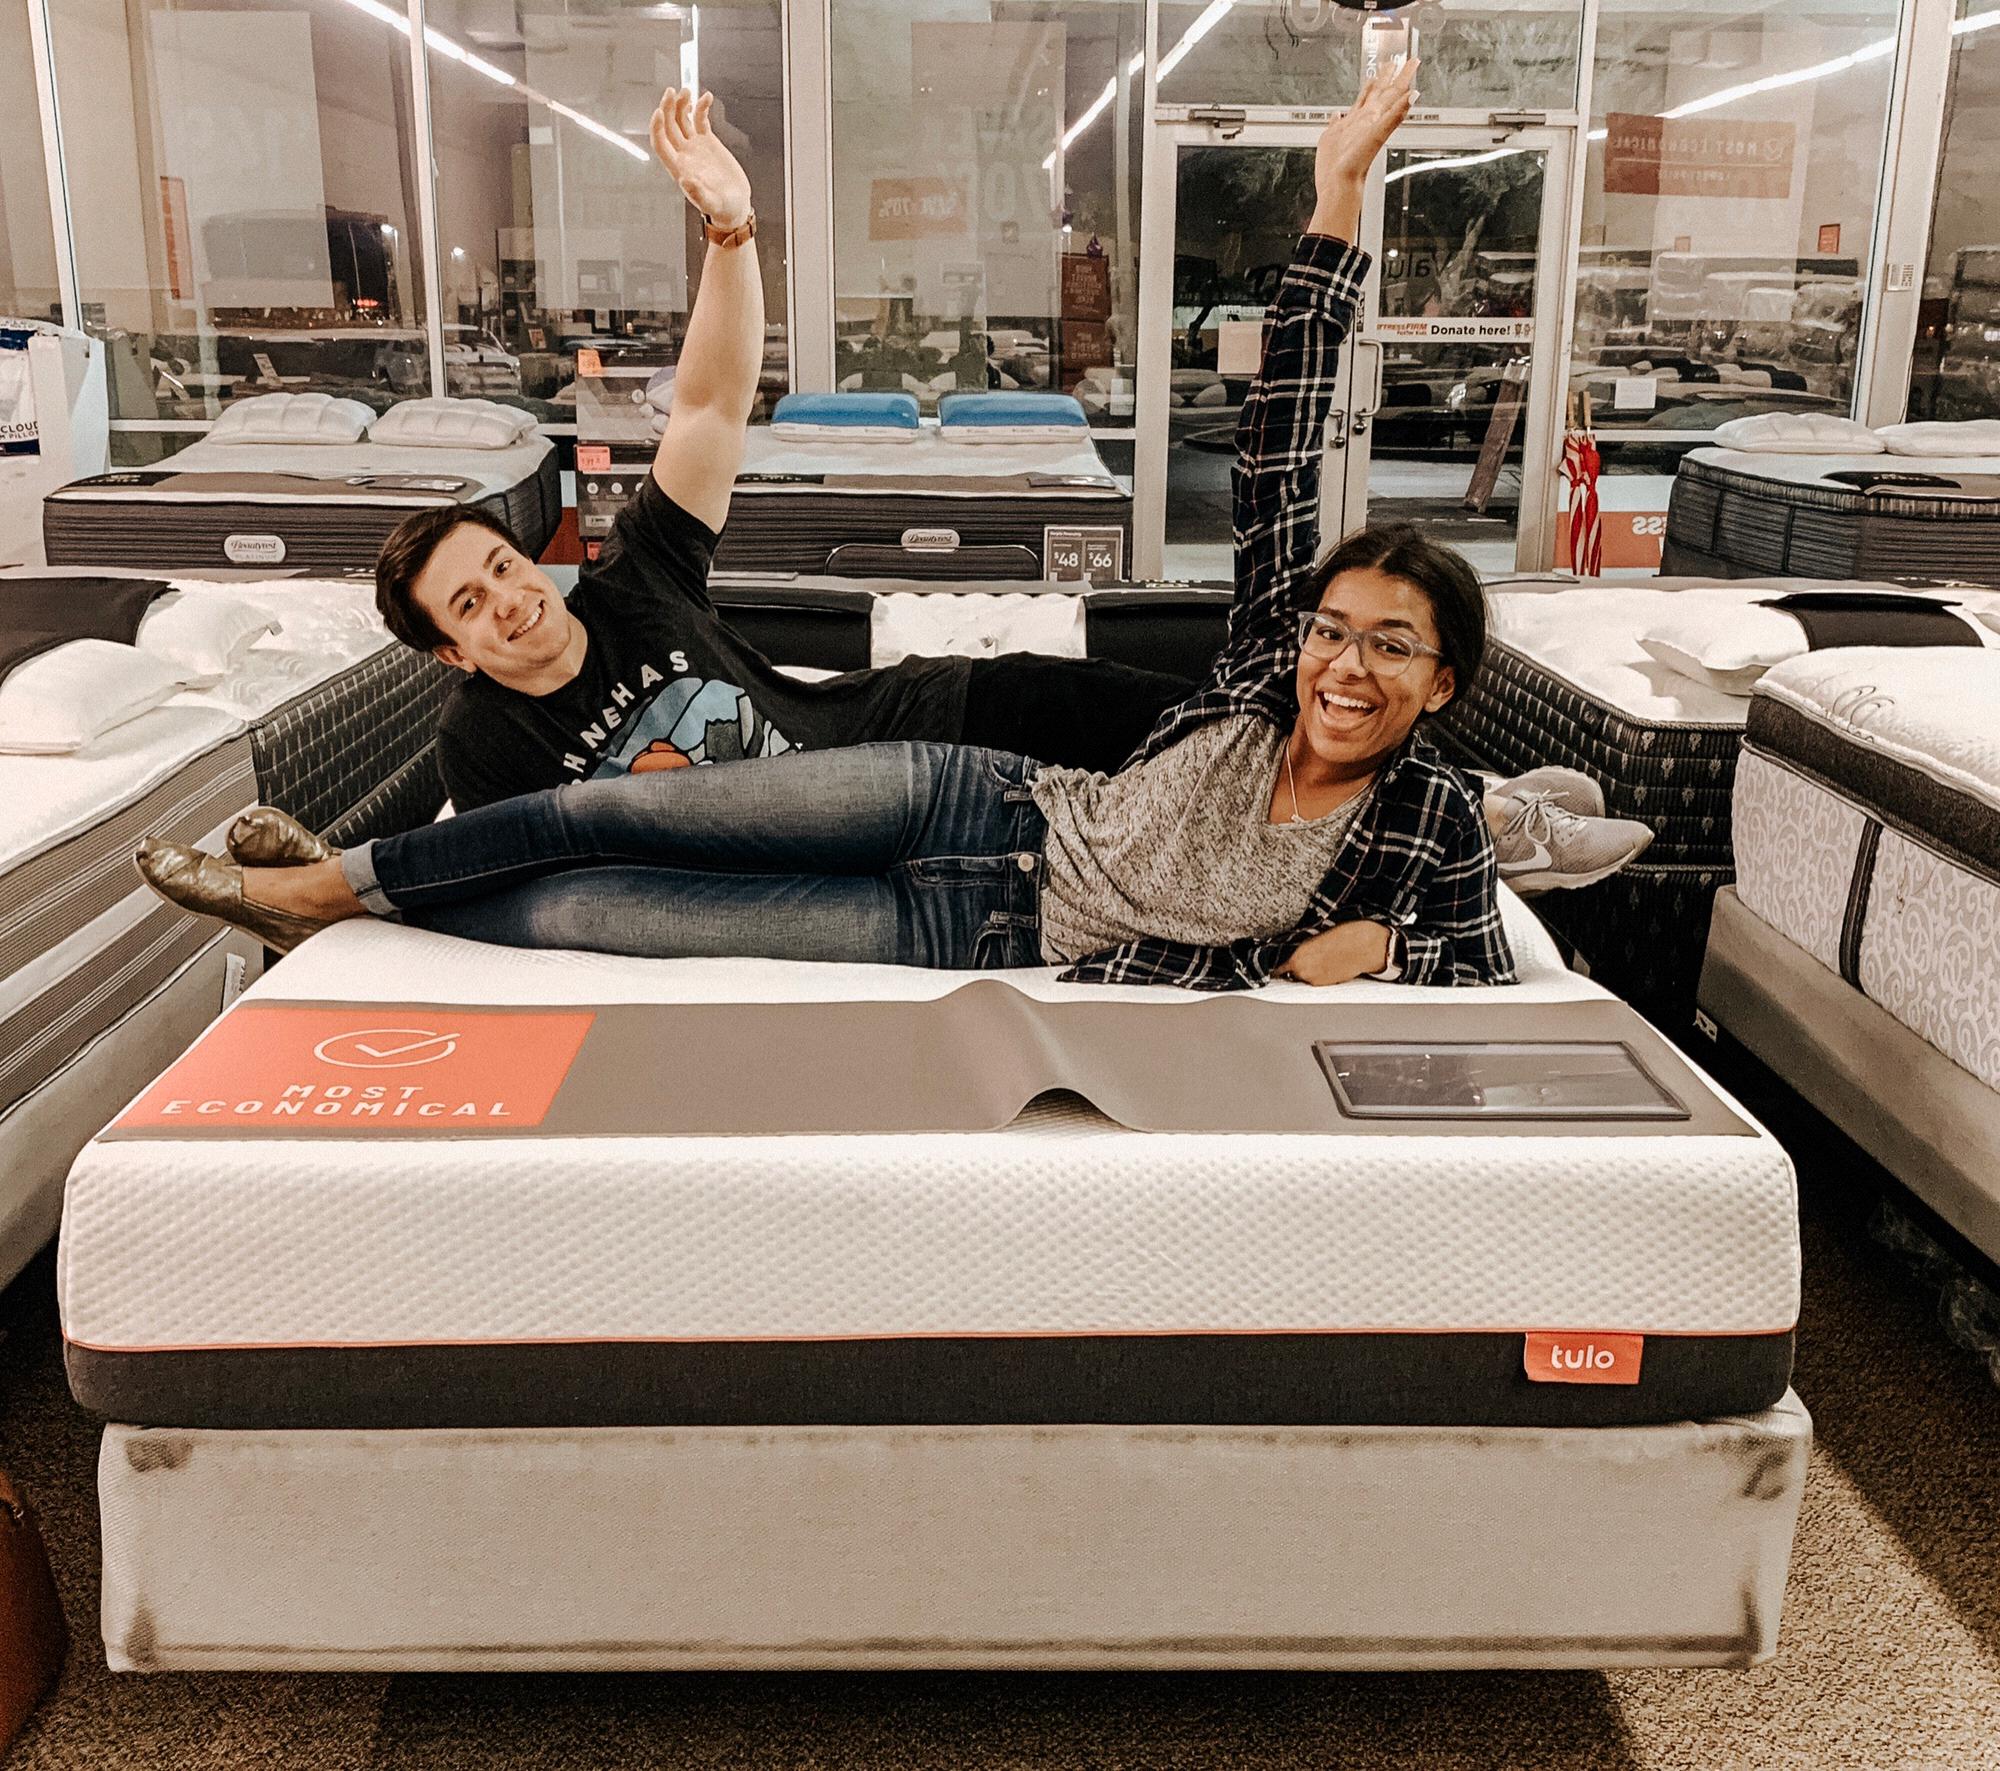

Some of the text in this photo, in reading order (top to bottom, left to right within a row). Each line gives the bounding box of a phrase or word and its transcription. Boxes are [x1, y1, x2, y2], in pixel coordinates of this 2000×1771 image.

[1430, 324, 1511, 336] Donate here!
[1053, 551, 1079, 568] $48
[1088, 551, 1113, 568] $66
[280, 1084, 424, 1100] MOST
[159, 1099, 512, 1117] ECONOMICAL
[1551, 1344, 1615, 1370] tulo
